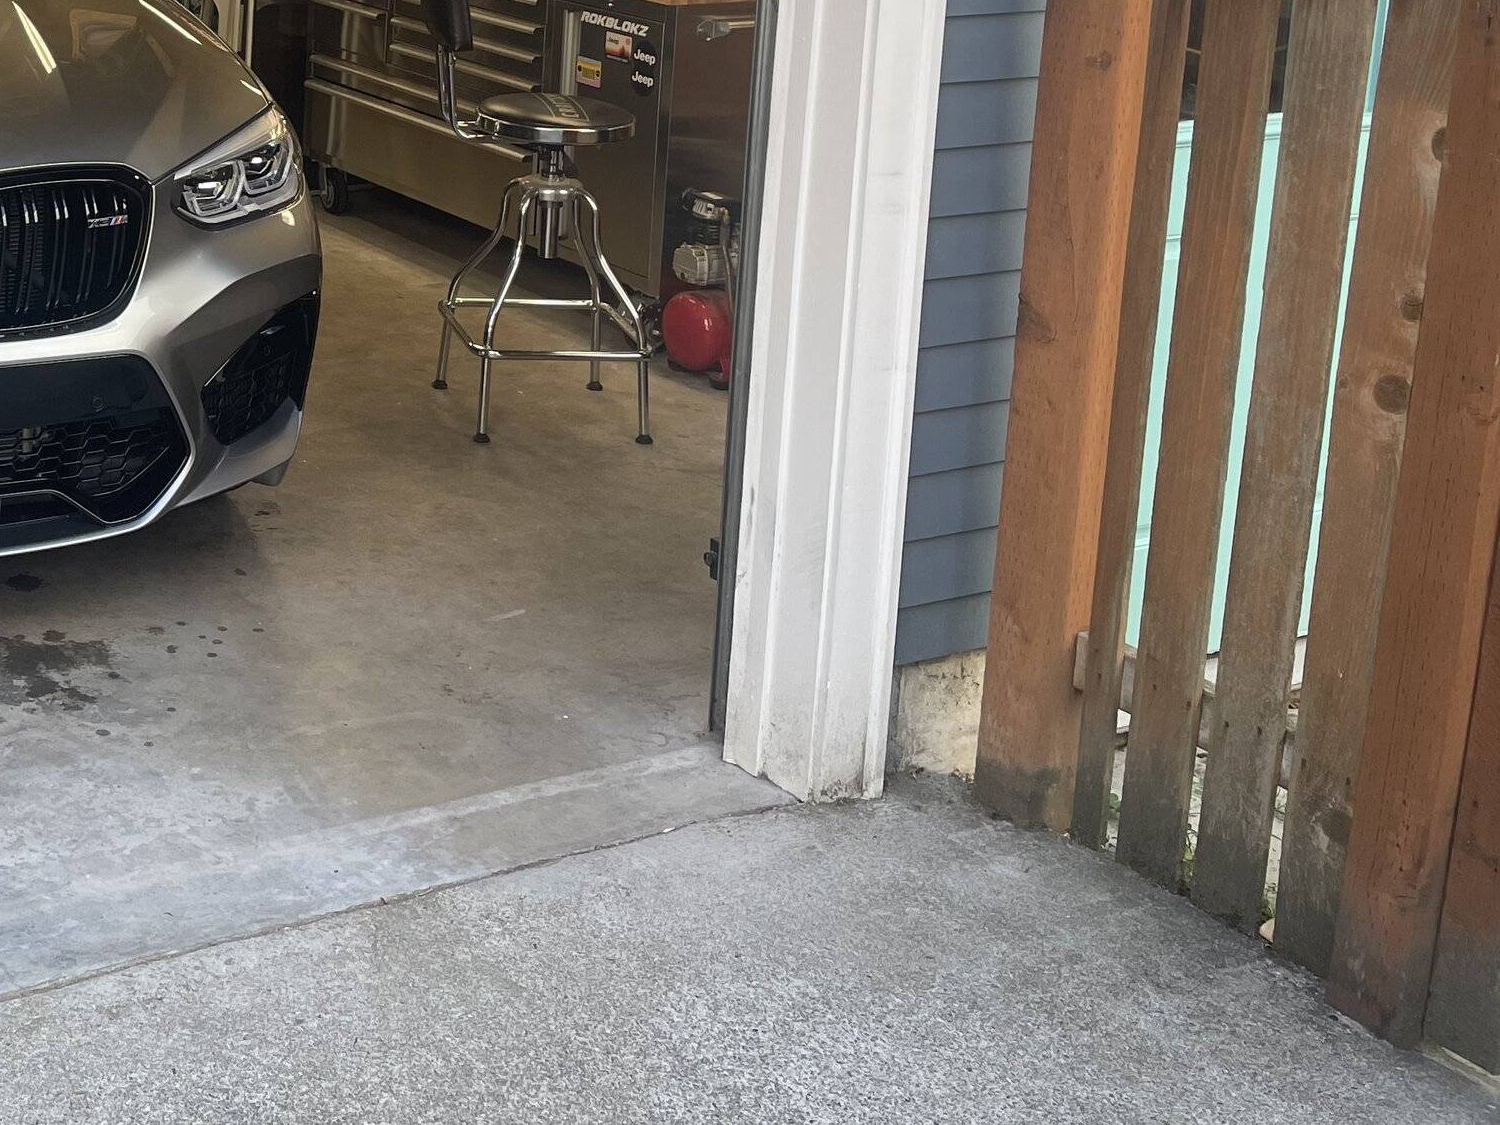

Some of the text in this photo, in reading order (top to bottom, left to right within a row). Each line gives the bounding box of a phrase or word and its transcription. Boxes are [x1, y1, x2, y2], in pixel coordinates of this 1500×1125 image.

[580, 10, 650, 38] ROKBLOKZ
[633, 48, 656, 66] Jeep
[631, 70, 654, 88] Jeep
